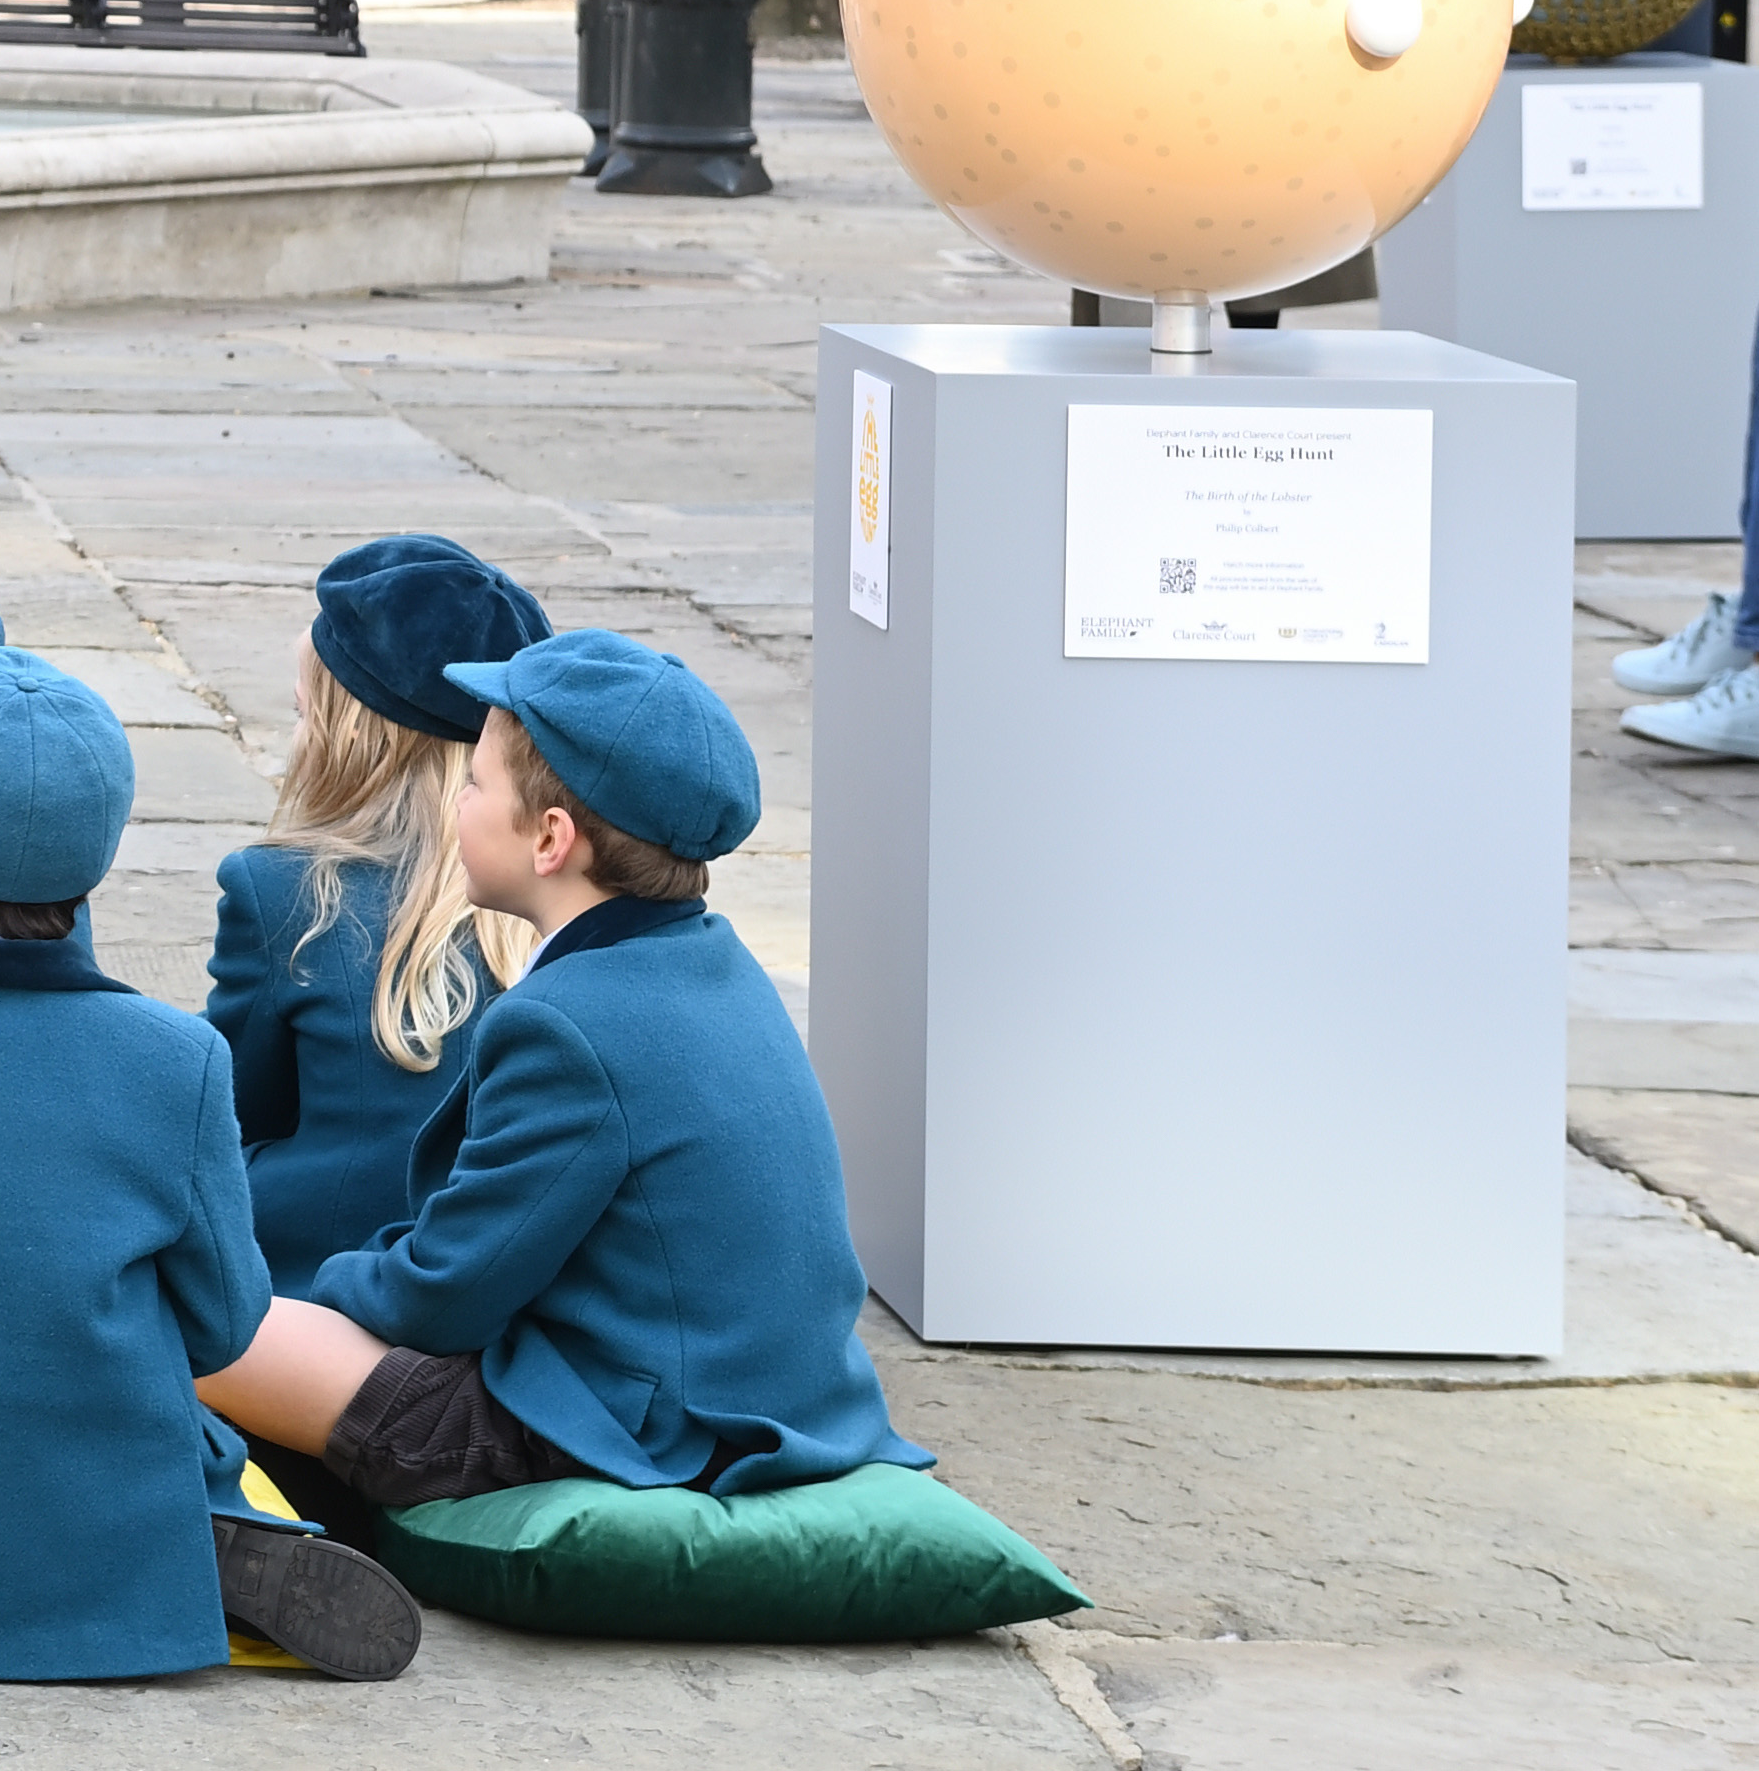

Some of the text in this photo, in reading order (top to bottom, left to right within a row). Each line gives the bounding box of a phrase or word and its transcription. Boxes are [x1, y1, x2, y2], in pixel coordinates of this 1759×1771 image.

[1146, 428, 1352, 442] Elephant Family and Clarence Court present
[1162, 444, 1334, 463] The Little Egg Hunt
[859, 476, 879, 521] egg
[1184, 490, 1312, 503] The Birth of the Lobster
[1215, 523, 1279, 534] Philip Colbert
[1081, 617, 1154, 628] ELEPHANT
[1081, 628, 1128, 638] FAMILY
[1172, 629, 1256, 641] Clarence Court
